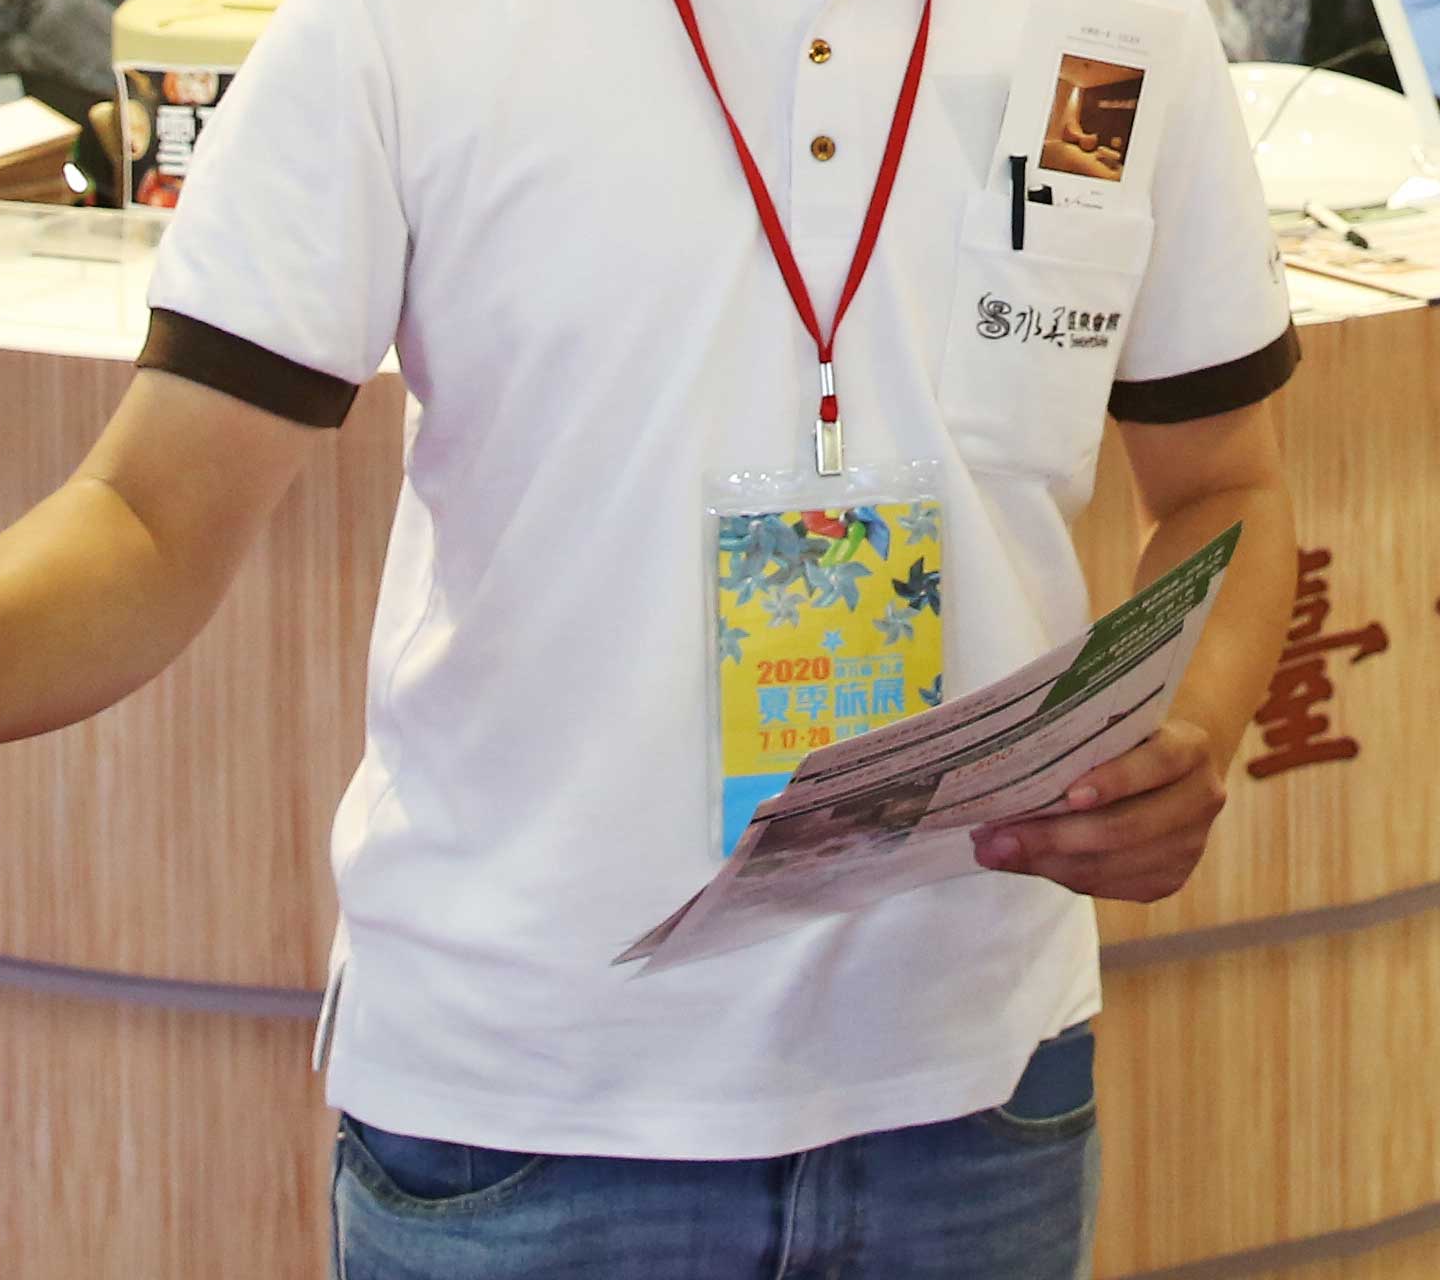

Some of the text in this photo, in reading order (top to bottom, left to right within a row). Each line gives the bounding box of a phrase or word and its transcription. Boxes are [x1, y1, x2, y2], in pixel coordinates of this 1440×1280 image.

[757, 656, 830, 685] 2020
[757, 678, 906, 725] 夏季旅展
